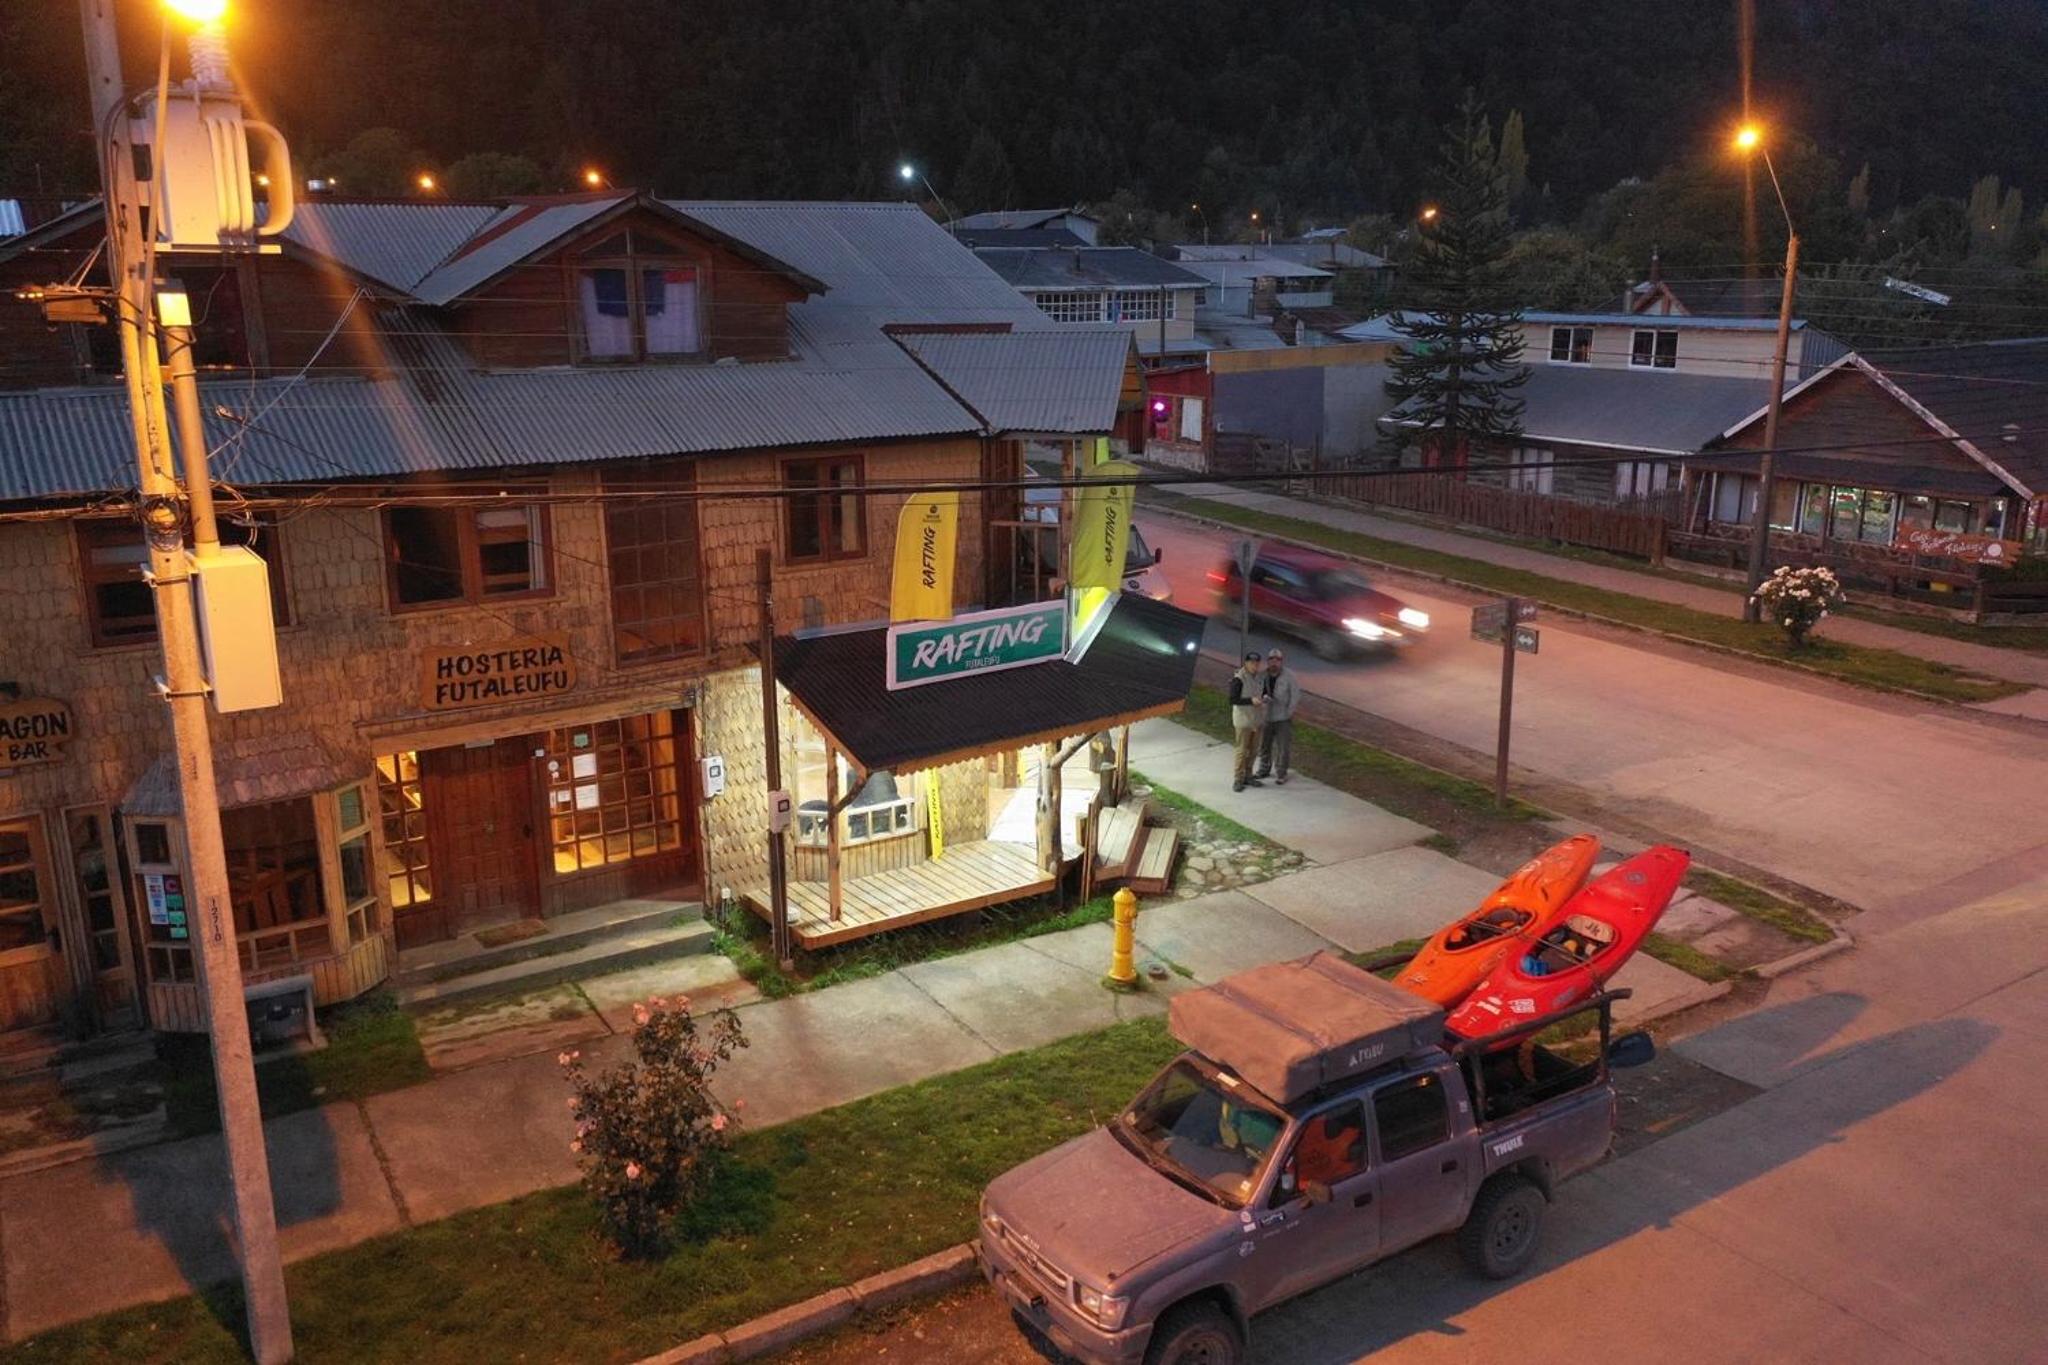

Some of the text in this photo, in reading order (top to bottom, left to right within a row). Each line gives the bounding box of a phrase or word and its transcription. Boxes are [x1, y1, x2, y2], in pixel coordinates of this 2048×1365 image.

[923, 526, 936, 589] RAFTING
[912, 616, 1048, 668] RAFTING
[437, 646, 563, 679] HOSTERIA
[436, 671, 567, 704] FUTALEUFU
[9, 741, 50, 761] BAR
